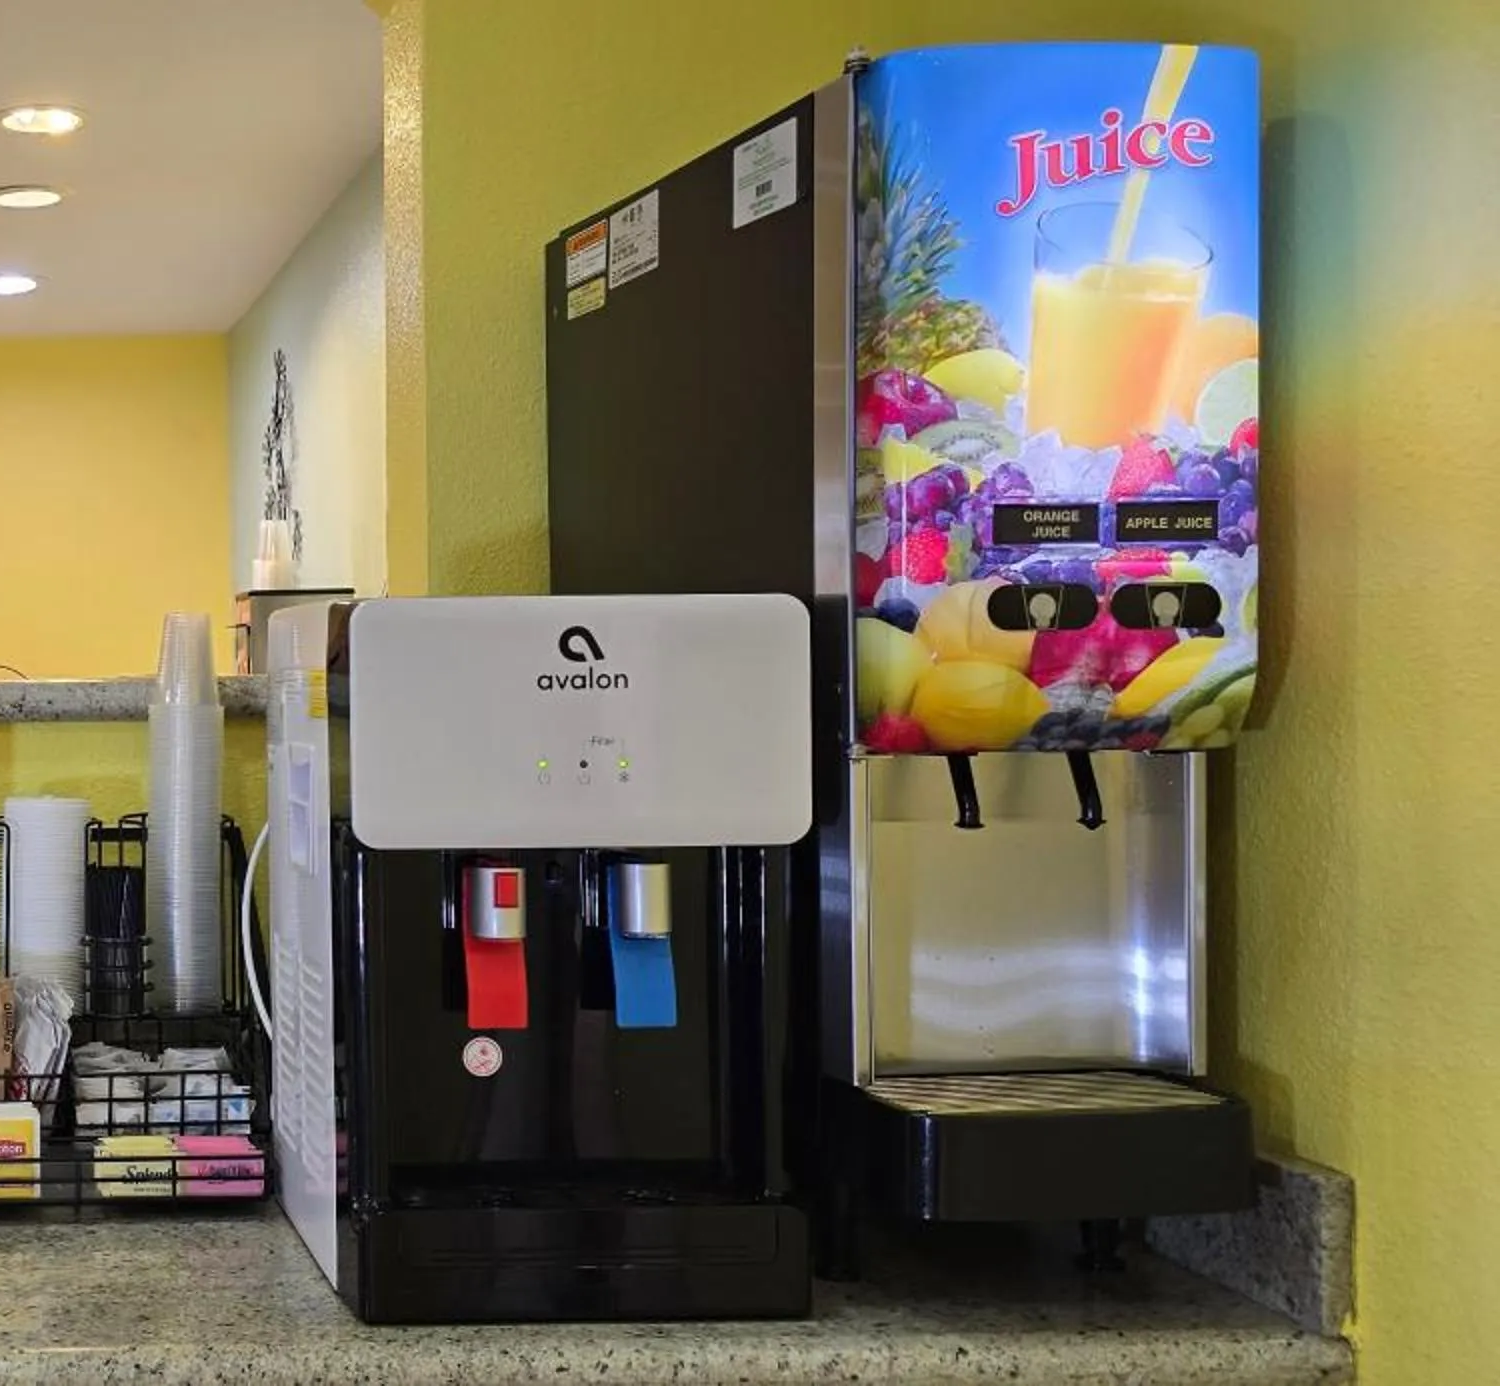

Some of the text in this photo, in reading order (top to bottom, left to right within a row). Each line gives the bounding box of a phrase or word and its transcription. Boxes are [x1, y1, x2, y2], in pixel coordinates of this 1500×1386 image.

[996, 108, 1214, 216] Juice
[1023, 510, 1080, 522] ORANGE
[1125, 516, 1213, 529] APPLE JUICE
[1032, 526, 1071, 539] JUICE
[537, 666, 629, 690] avalon
[122, 1165, 175, 1184] Splend
